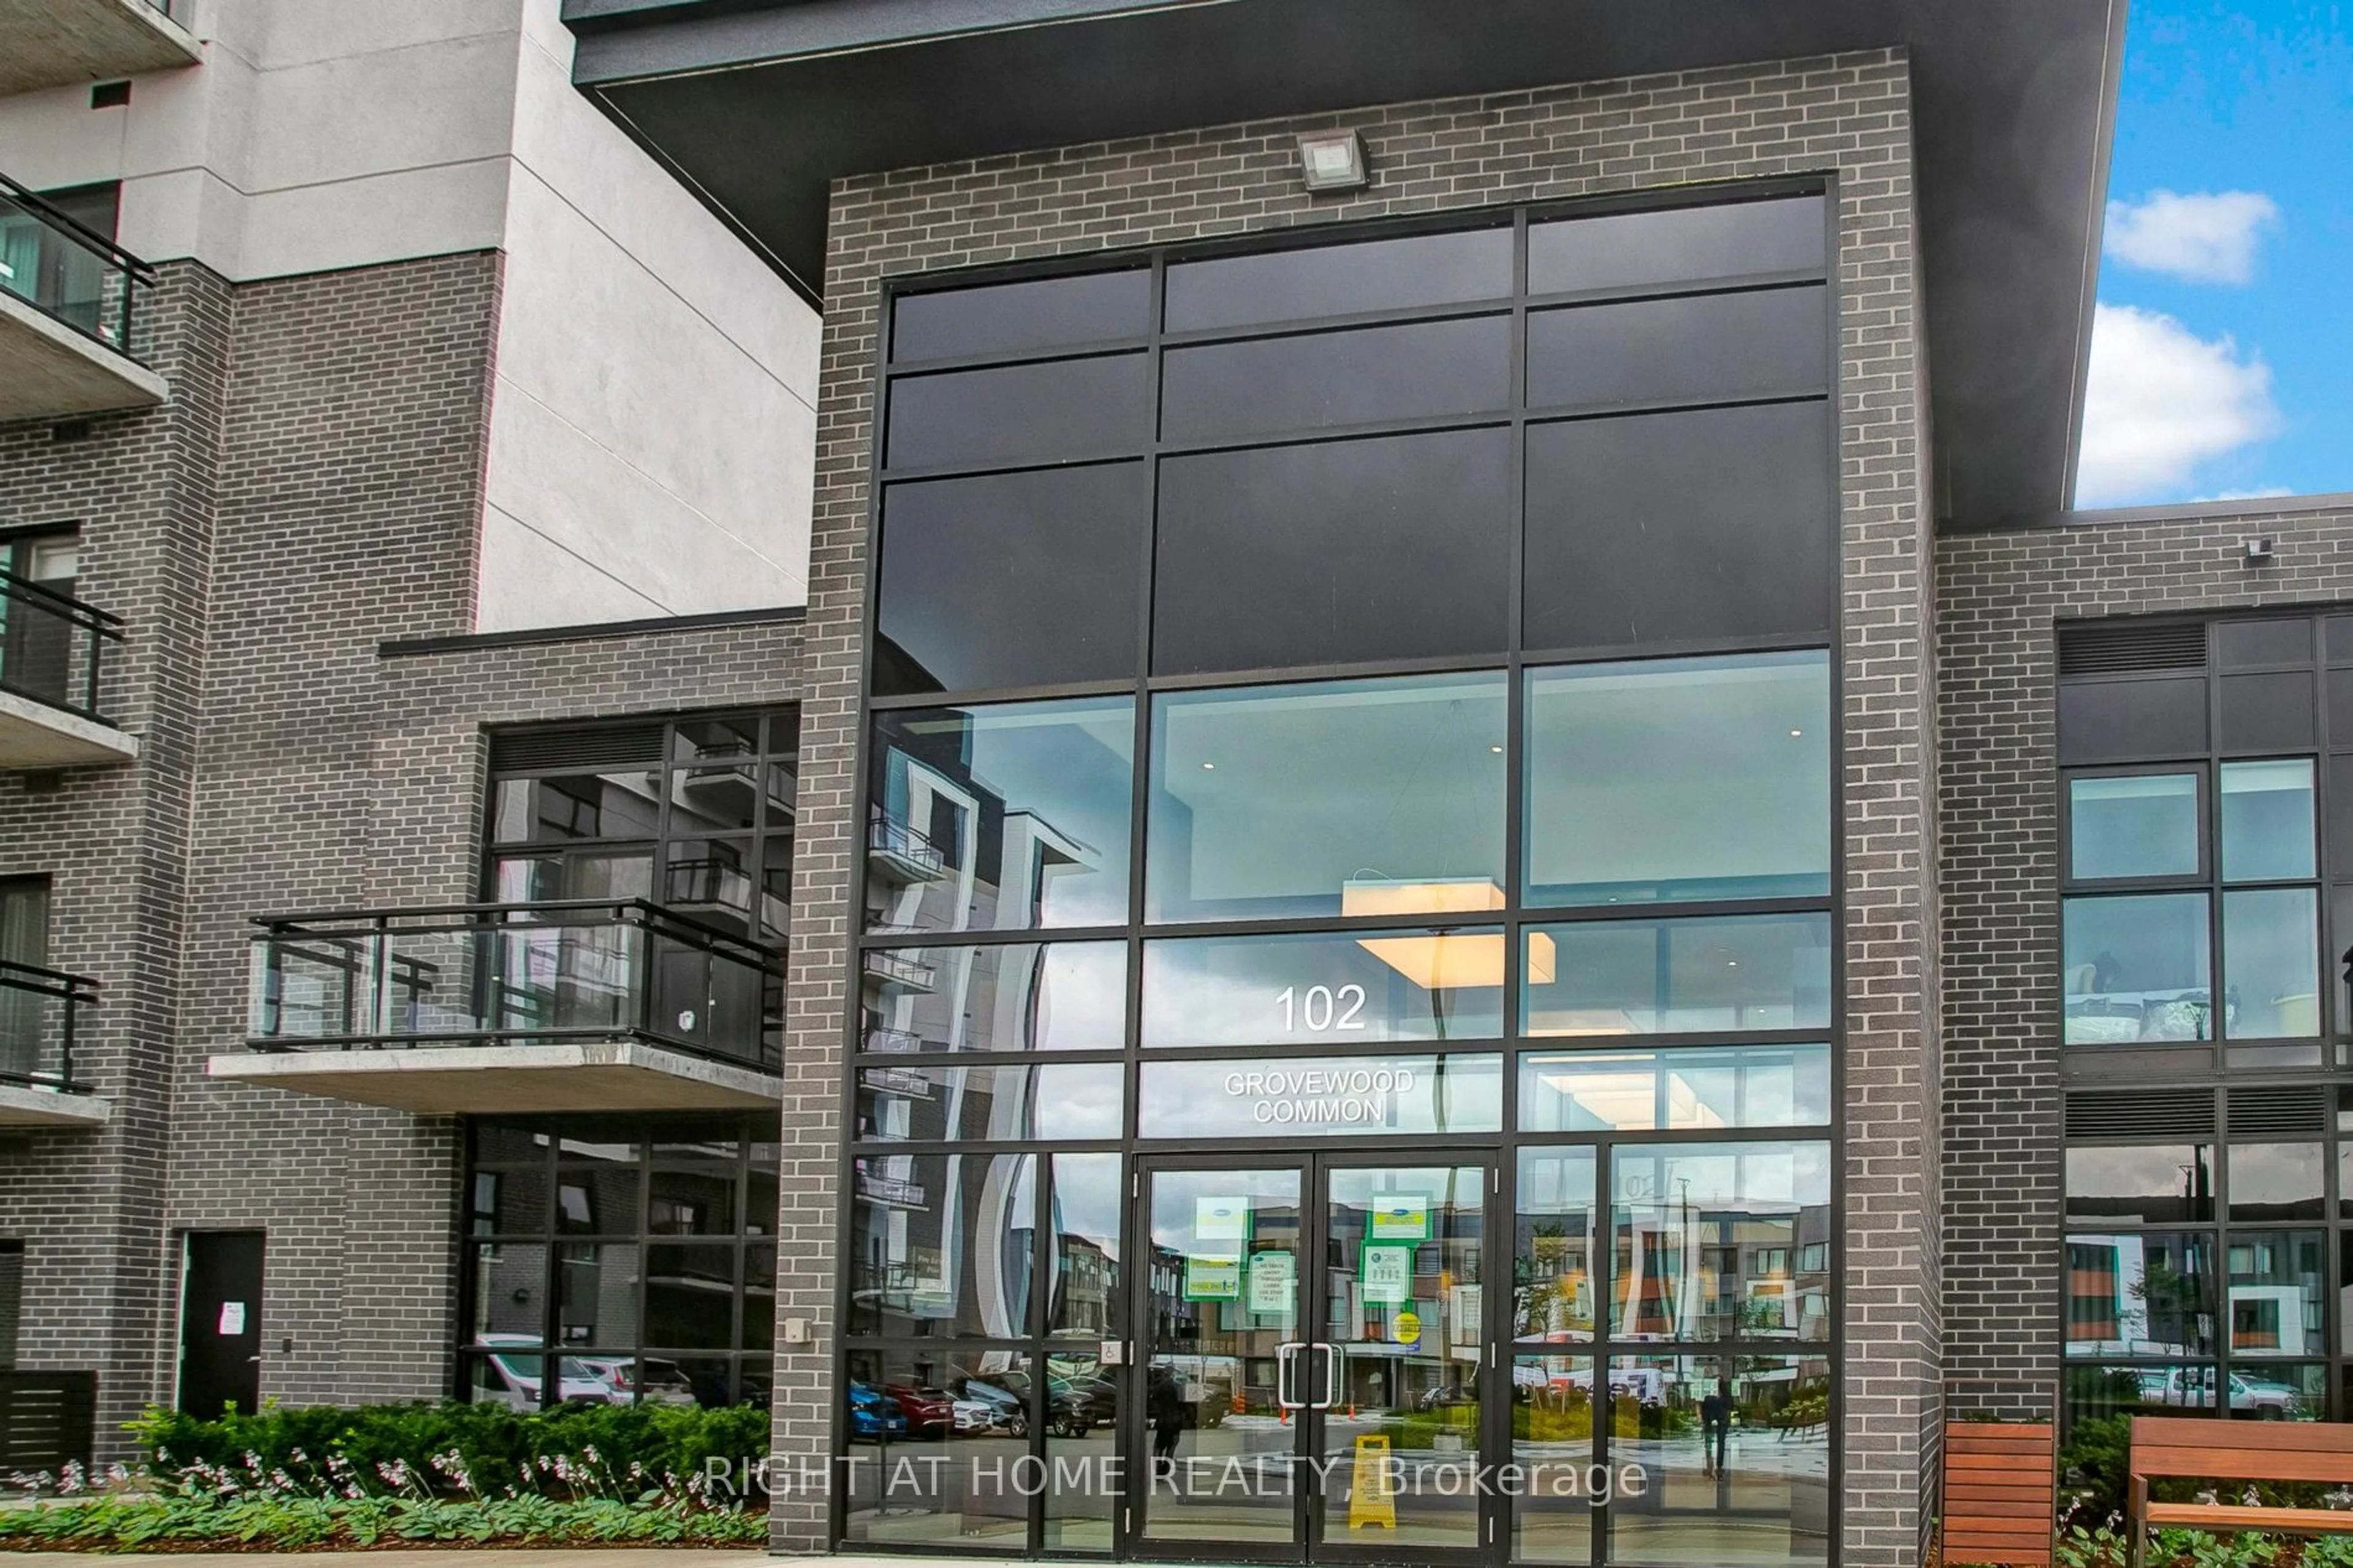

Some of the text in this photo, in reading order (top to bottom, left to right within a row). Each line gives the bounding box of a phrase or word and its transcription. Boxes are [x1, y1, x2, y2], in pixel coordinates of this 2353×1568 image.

[1276, 983, 1366, 1031] 102
[1224, 1069, 1414, 1096] GROVEWOOD
[1254, 1098, 1382, 1123] COMMON
